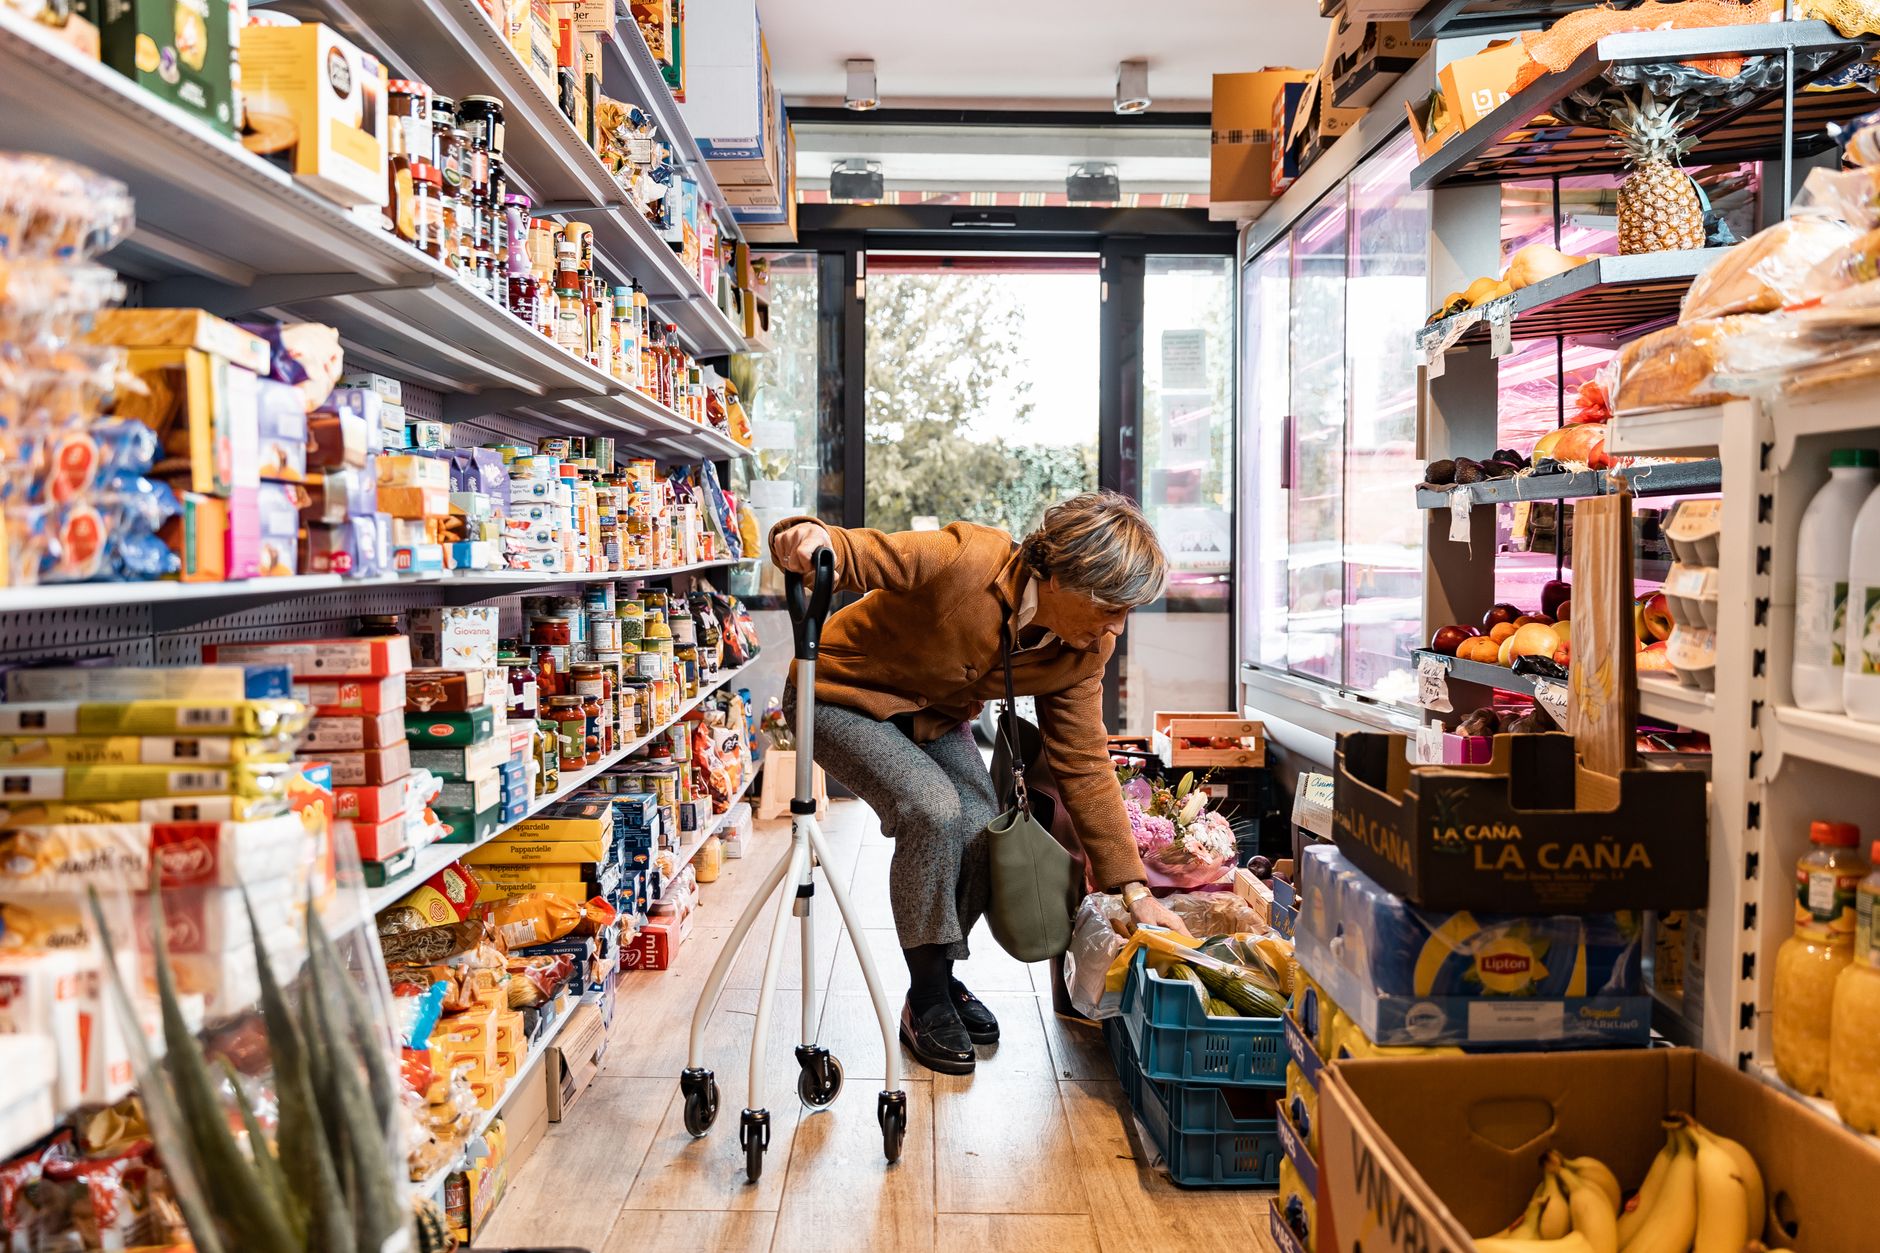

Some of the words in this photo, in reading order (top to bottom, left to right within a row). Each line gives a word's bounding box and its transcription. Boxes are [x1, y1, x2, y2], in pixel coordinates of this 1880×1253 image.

[454, 627, 491, 636] Giovanna
[1434, 827, 1458, 840] LA
[1464, 822, 1522, 840] CAÑA
[1351, 808, 1369, 846] LA
[1370, 820, 1414, 877] CAÑA
[510, 846, 551, 855] Pappardelle
[1474, 843, 1525, 870] LA
[1538, 836, 1652, 870] CAÑA
[490, 864, 530, 873] Pappardelle
[496, 884, 537, 892] Pappardelle
[645, 934, 659, 968] mini
[1485, 957, 1526, 971] Lipton
